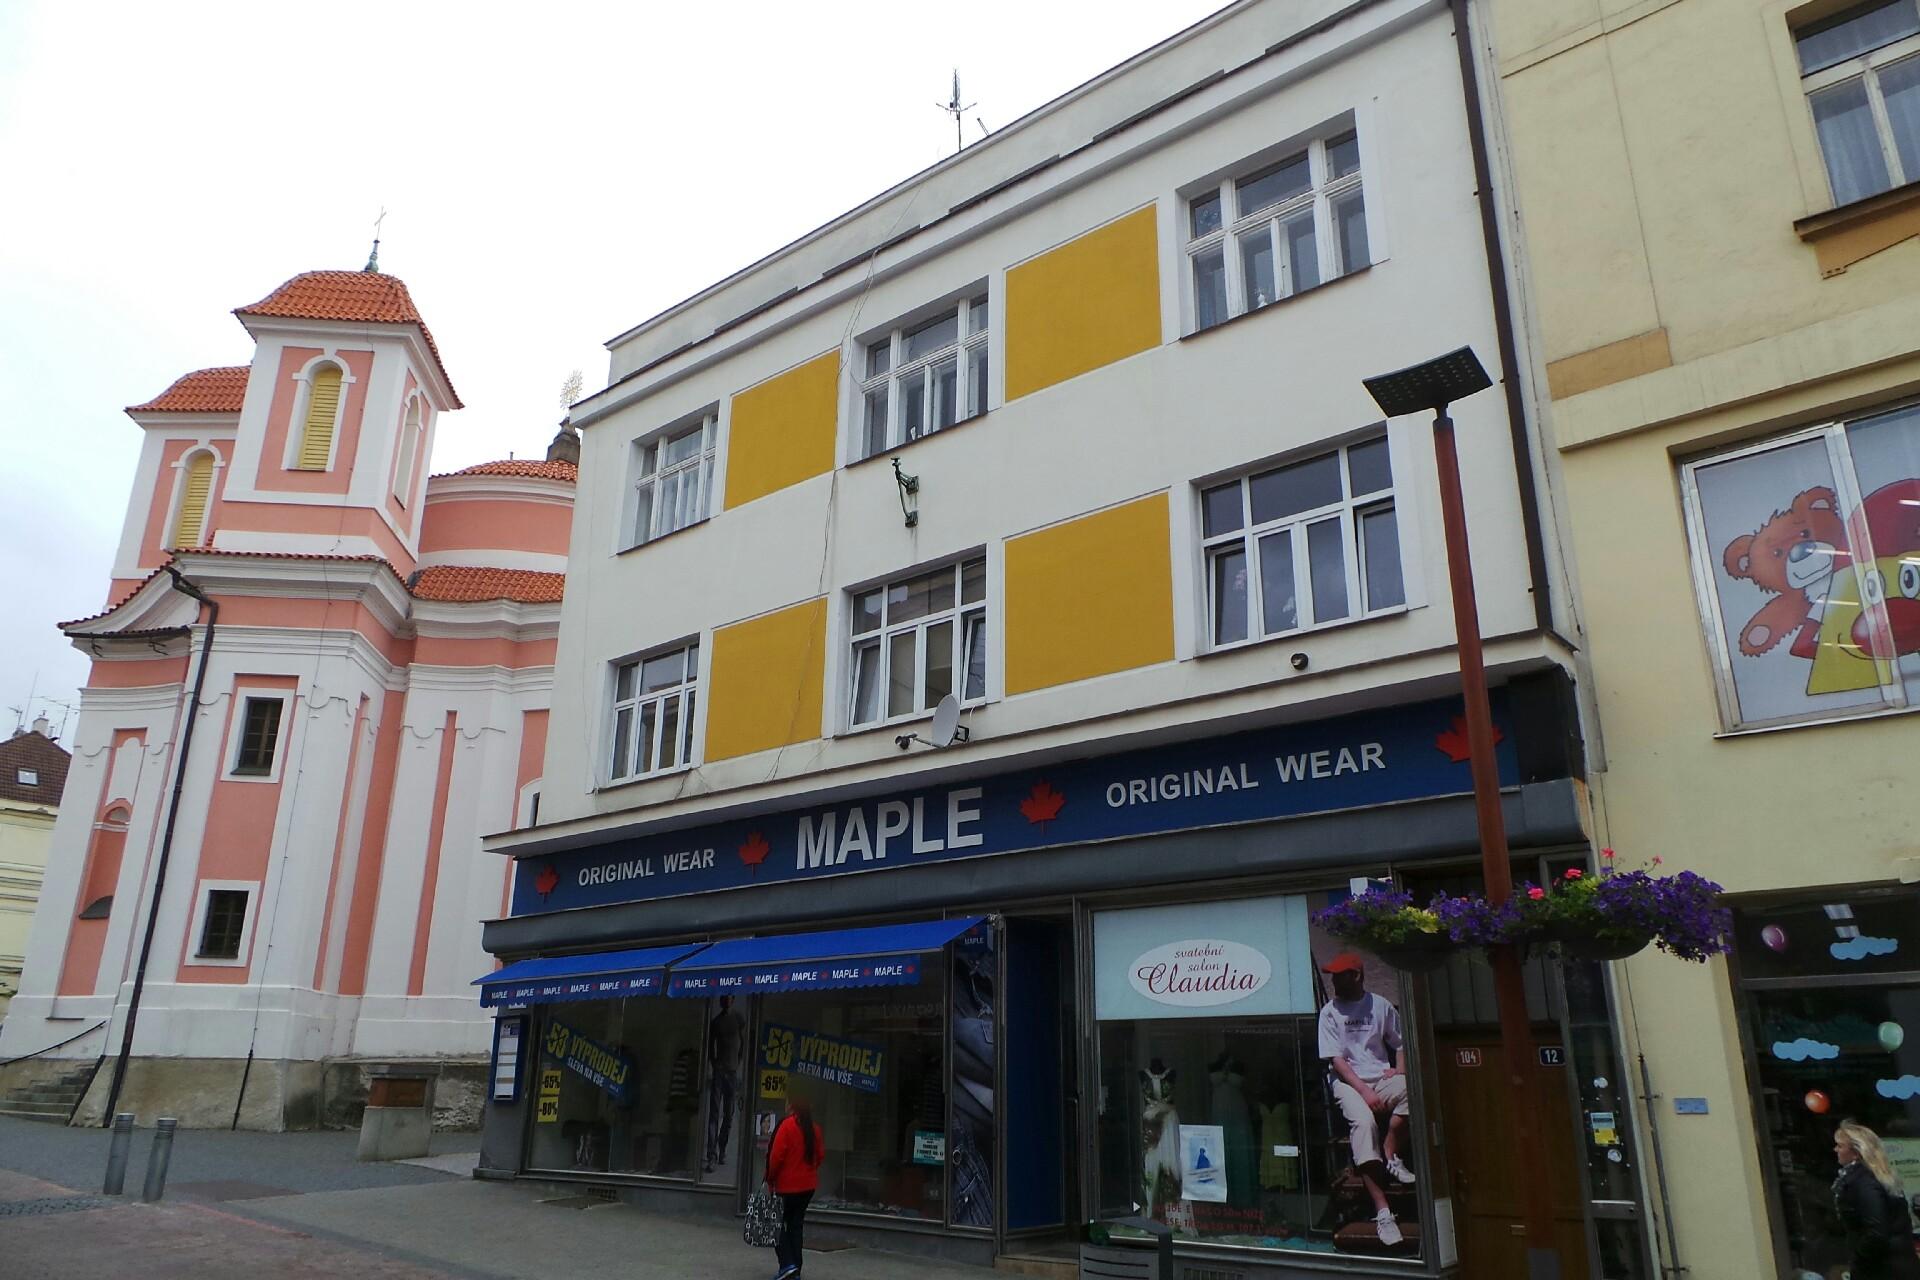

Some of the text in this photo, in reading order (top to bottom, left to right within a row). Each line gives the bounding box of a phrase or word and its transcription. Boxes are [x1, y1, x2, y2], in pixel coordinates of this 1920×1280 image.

[1106, 742, 1386, 808] ORIGINAL WEAR
[796, 786, 984, 870] MAPLE
[577, 847, 716, 887] ORIGINAL WEAR
[684, 965, 903, 989] MAPLE MAPLE MAPLE MAPLE MAPLE MAPLE
[1137, 962, 1261, 995] Claudia
[1187, 958, 1220, 973] salon
[491, 978, 651, 1000] MAPLE MAPLE MAPLE MAPLE MAPLE MAPLE
[571, 1034, 628, 1085] VÝPRODEJ
[799, 1033, 883, 1078] VÝPRODEJ
[1459, 1049, 1477, 1064] 104
[1544, 1049, 1559, 1064] 12
[796, 1061, 854, 1086] SLEVA NA VŠE
